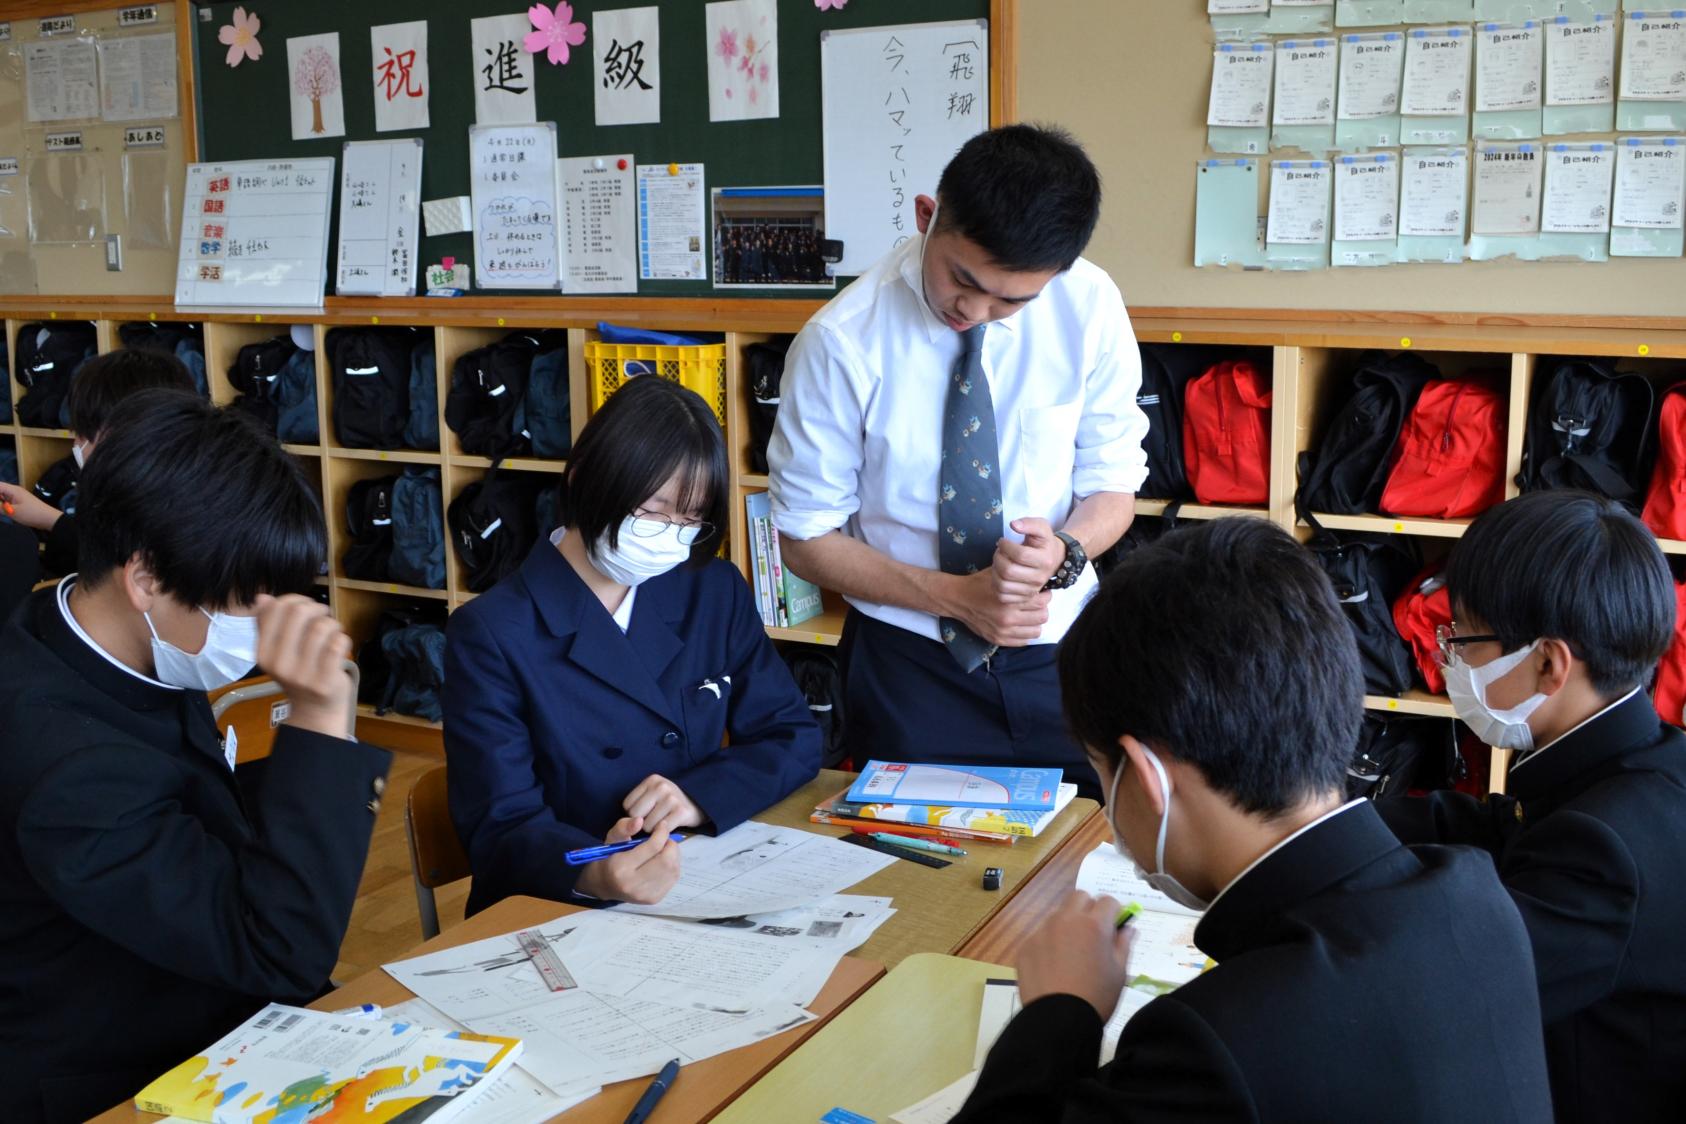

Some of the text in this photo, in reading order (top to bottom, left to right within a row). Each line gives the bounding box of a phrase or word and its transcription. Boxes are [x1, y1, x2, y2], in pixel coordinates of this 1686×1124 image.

[376, 46, 423, 101] 祝
[482, 40, 529, 94] 進
[603, 39, 654, 90] 級
[127, 131, 164, 143] あしあと
[204, 199, 224, 213] 国語
[200, 241, 222, 255] 数学
[792, 593, 819, 613] Campus
[1014, 769, 1048, 801] Campus
